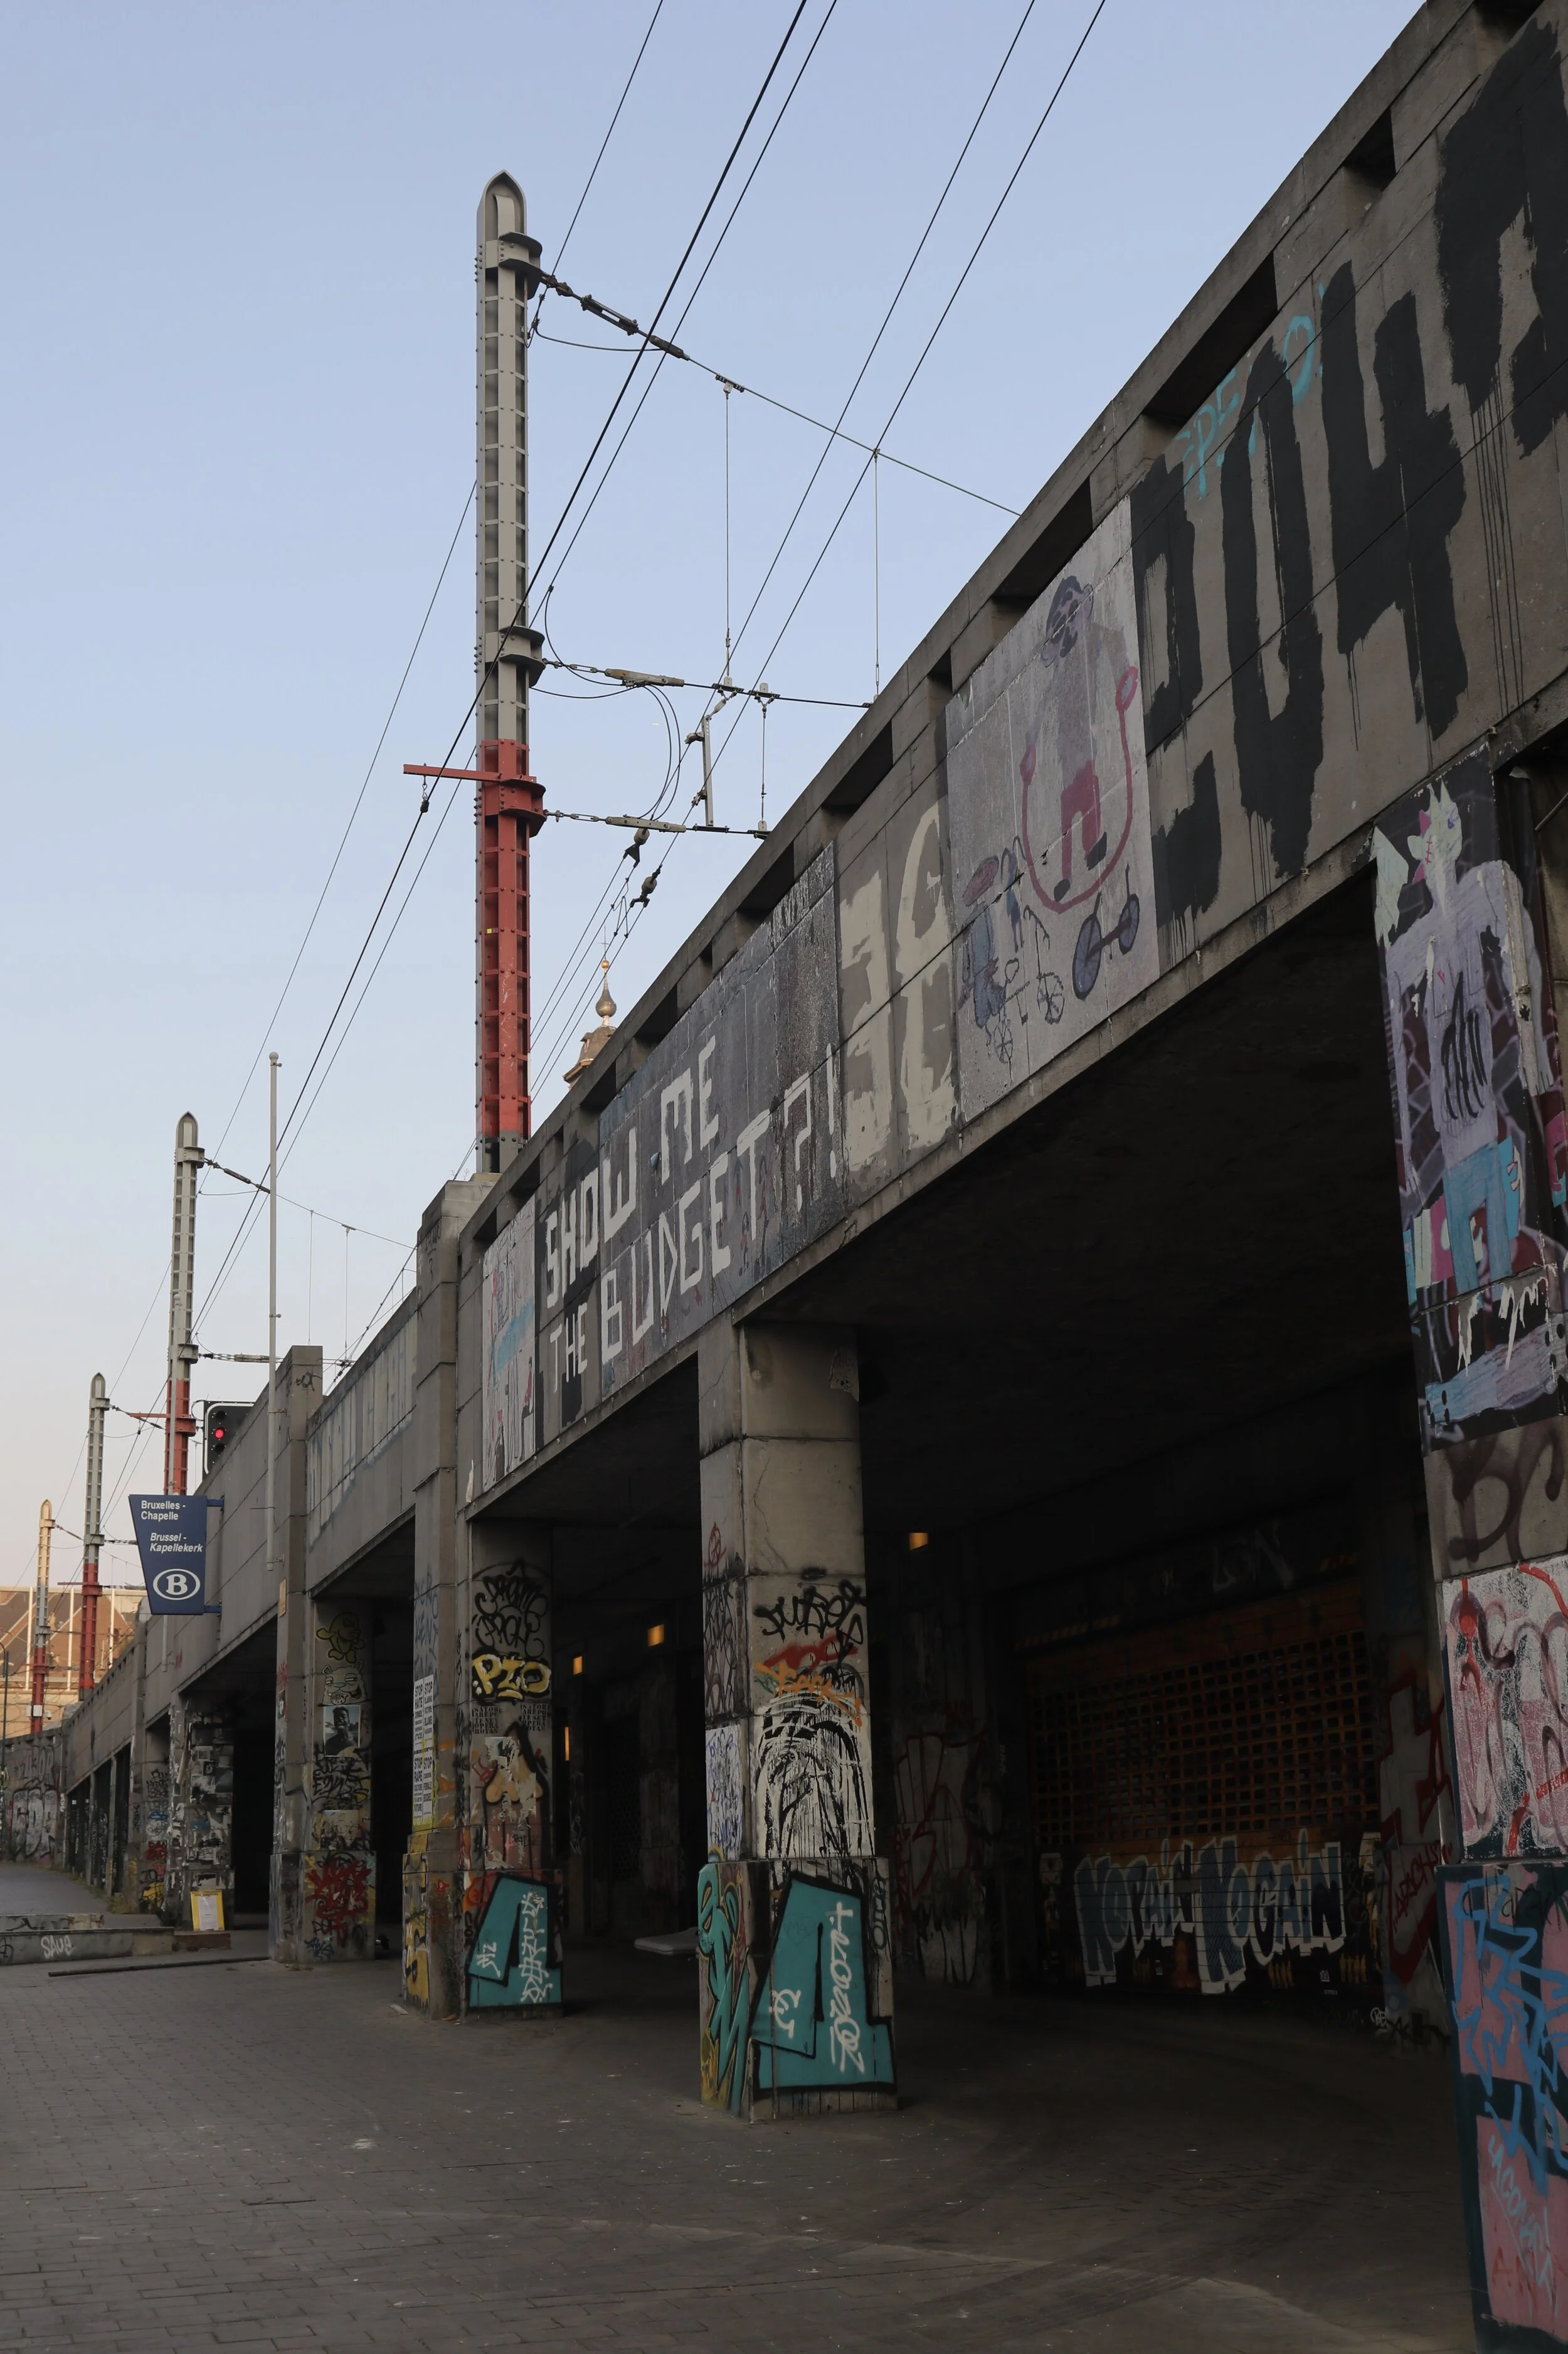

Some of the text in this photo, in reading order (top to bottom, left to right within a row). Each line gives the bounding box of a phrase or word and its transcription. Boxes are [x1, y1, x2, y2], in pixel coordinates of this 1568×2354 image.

[546, 1036, 719, 1309] SHOW ME
[549, 1302, 588, 1393] THE
[141, 1500, 180, 1510] Bruxelles
[140, 1511, 179, 1522] Chapelle
[150, 1532, 182, 1542] Brussel
[149, 1543, 203, 1554] Kapellekerk
[165, 1574, 188, 1595] B
[424, 1681, 433, 1695] STOP
